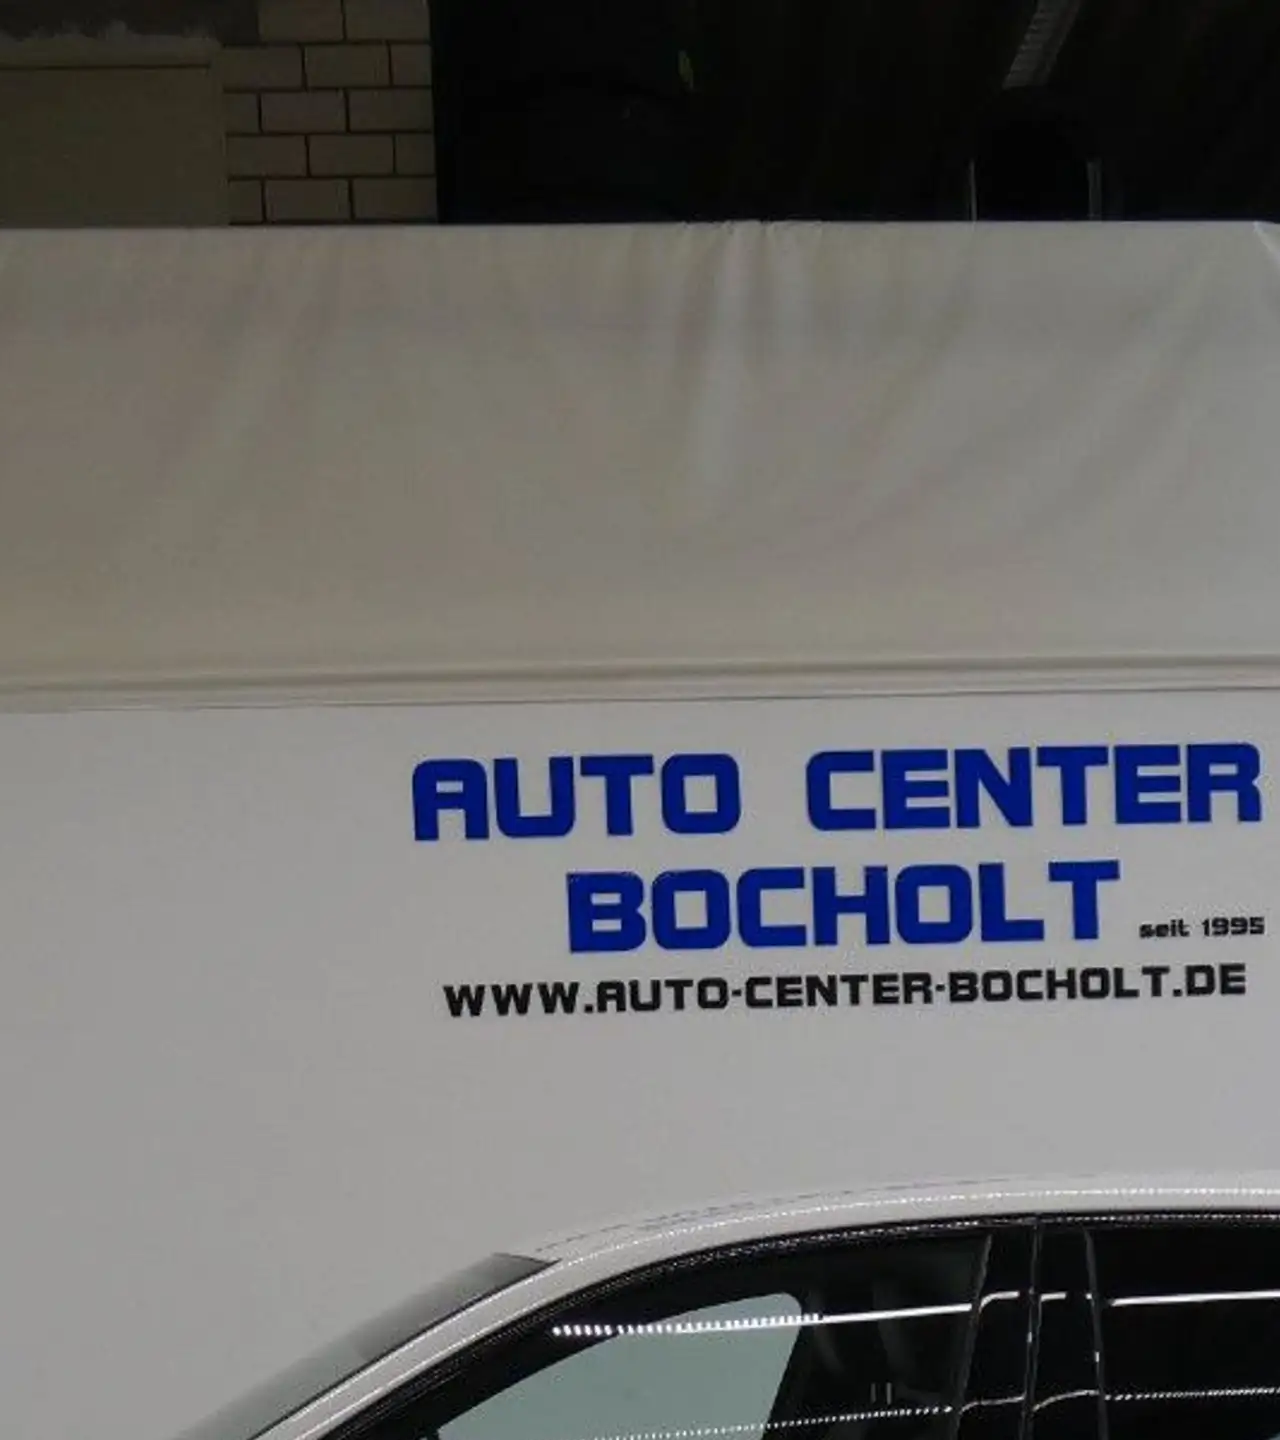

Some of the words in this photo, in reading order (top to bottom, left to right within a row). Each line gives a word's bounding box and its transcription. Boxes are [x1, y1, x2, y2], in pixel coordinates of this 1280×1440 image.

[412, 754, 741, 842] AUTO
[806, 743, 1263, 833] CENTER
[567, 860, 1120, 954] BOCHOLT
[1138, 918, 1191, 939] seit
[1201, 916, 1266, 938] 1995
[442, 962, 1247, 1019] WWW.AUTO-CENTER-BOCHOLT.DE
